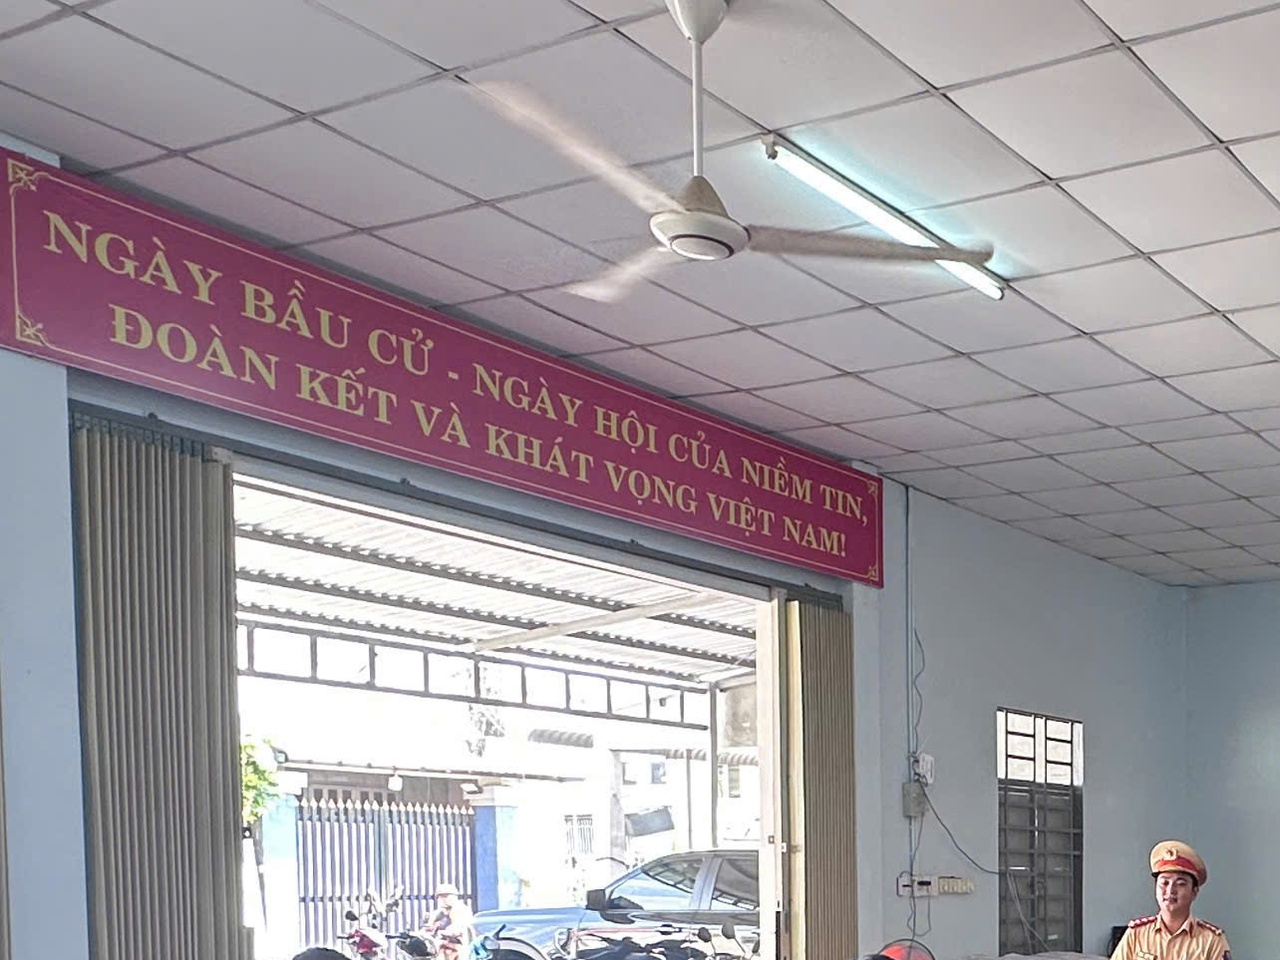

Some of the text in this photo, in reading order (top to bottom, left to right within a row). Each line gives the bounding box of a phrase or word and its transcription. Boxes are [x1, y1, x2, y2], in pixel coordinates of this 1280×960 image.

[43, 209, 223, 305] NGÀY
[240, 279, 352, 349] BẦU
[368, 326, 434, 376] CỬ
[471, 362, 583, 427] NGÀY
[594, 404, 656, 454] HỘI
[668, 430, 733, 479] CỦA
[740, 456, 813, 503] NIỀM
[820, 483, 869, 527] TIN,
[108, 303, 848, 557] ĐOÀN KẾT VÀ KHÁT VỌNG VIỆT NAM!
